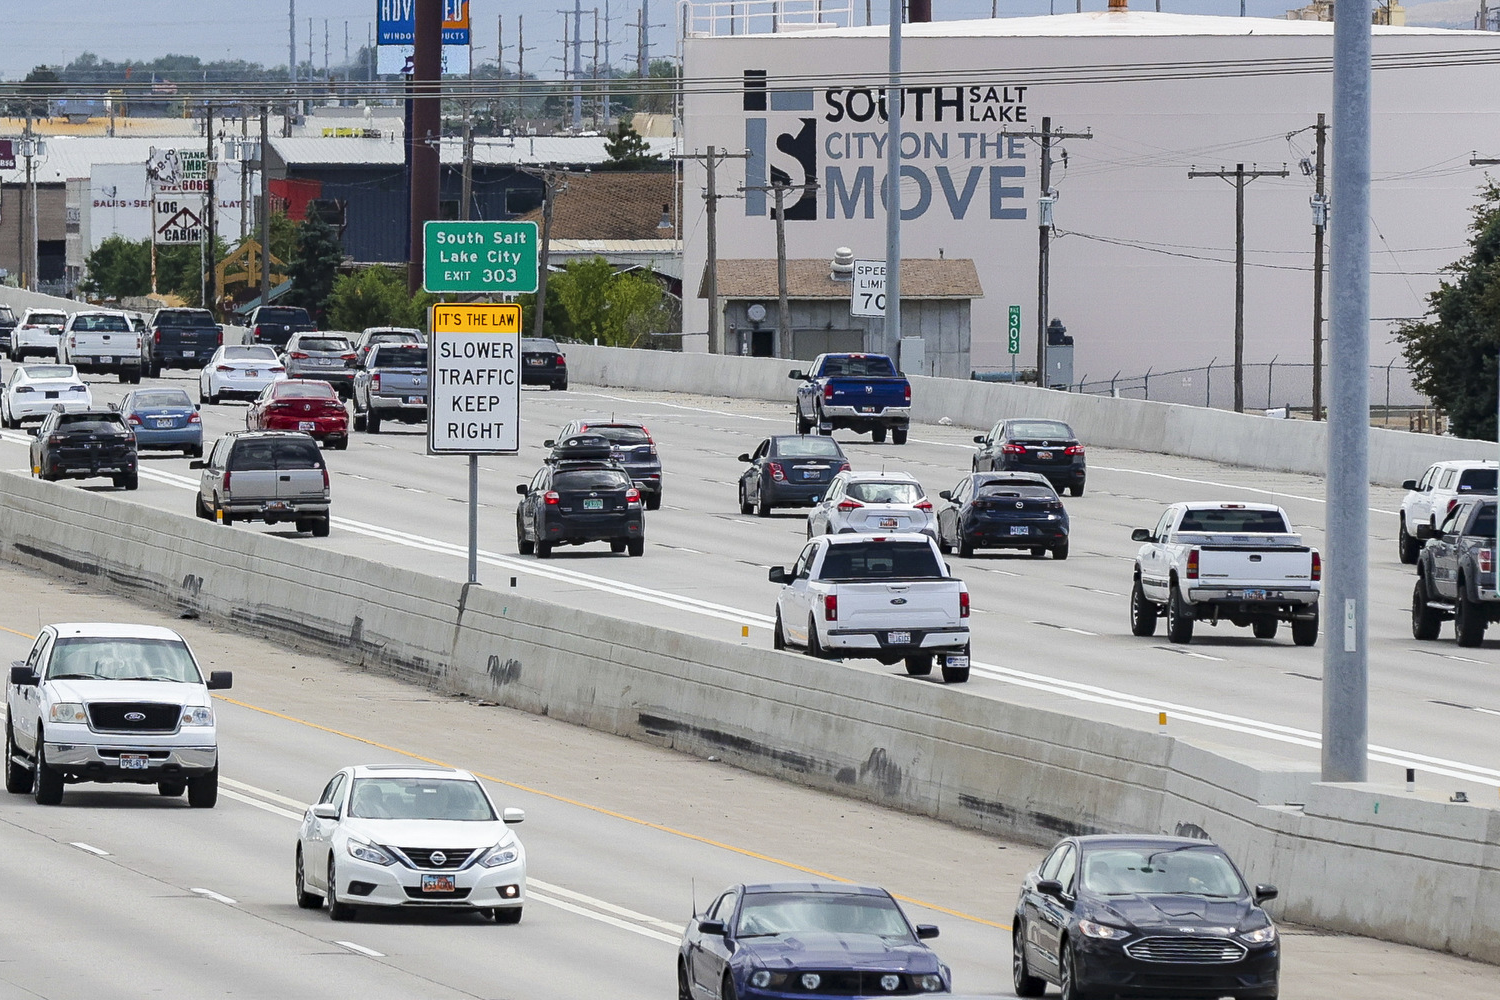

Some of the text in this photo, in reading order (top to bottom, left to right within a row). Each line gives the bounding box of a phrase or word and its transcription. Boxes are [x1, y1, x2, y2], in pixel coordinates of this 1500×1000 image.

[825, 86, 1027, 122] SOUTH SALT
[969, 105, 1028, 122] LAKE
[825, 131, 1027, 159] CITY ON THE
[825, 164, 1028, 220] MOVE
[157, 201, 178, 213] LOG
[436, 231, 527, 244] South Salt
[440, 250, 522, 265] Lake City
[444, 269, 517, 283] EXIT 303
[857, 266, 887, 276] SPEE
[438, 313, 515, 326] IT'S THE LAW
[1009, 314, 1019, 352] 303
[440, 342, 514, 358] SLOWER
[438, 369, 515, 385] TRAFFIC
[452, 396, 500, 412] KEEP
[447, 423, 504, 438] RIGHT
